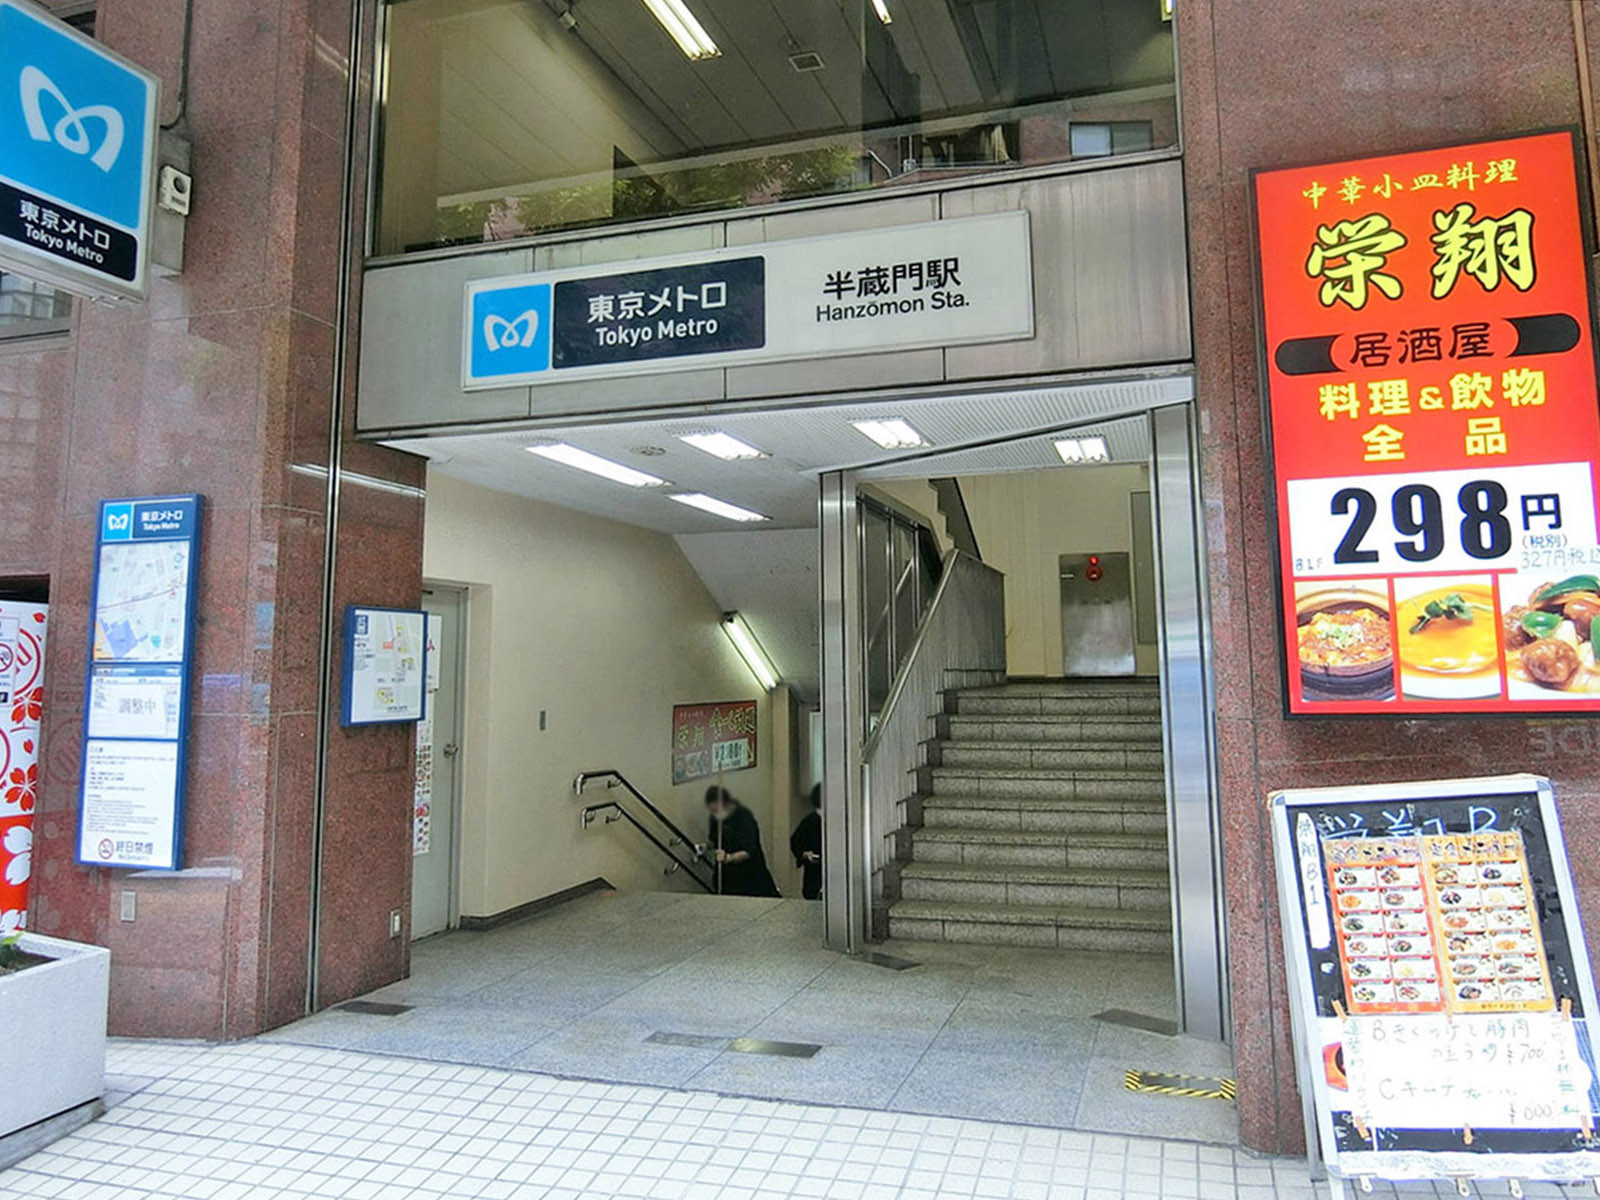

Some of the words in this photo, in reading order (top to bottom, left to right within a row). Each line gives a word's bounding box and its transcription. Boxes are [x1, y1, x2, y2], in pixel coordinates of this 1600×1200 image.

[1302, 158, 1519, 209] 中華小皿料理
[19, 199, 111, 250] 東京メトロ
[24, 223, 64, 249] Tokyo
[66, 239, 104, 264] Metro
[1306, 202, 1537, 310] 栄翔
[823, 257, 962, 300] 半蔵門駅
[587, 281, 727, 324] 東京メトロ
[930, 291, 970, 310] Sta.
[595, 325, 653, 348] Tokyo
[657, 318, 718, 340] Metro
[1349, 322, 1496, 368] 居酒屋
